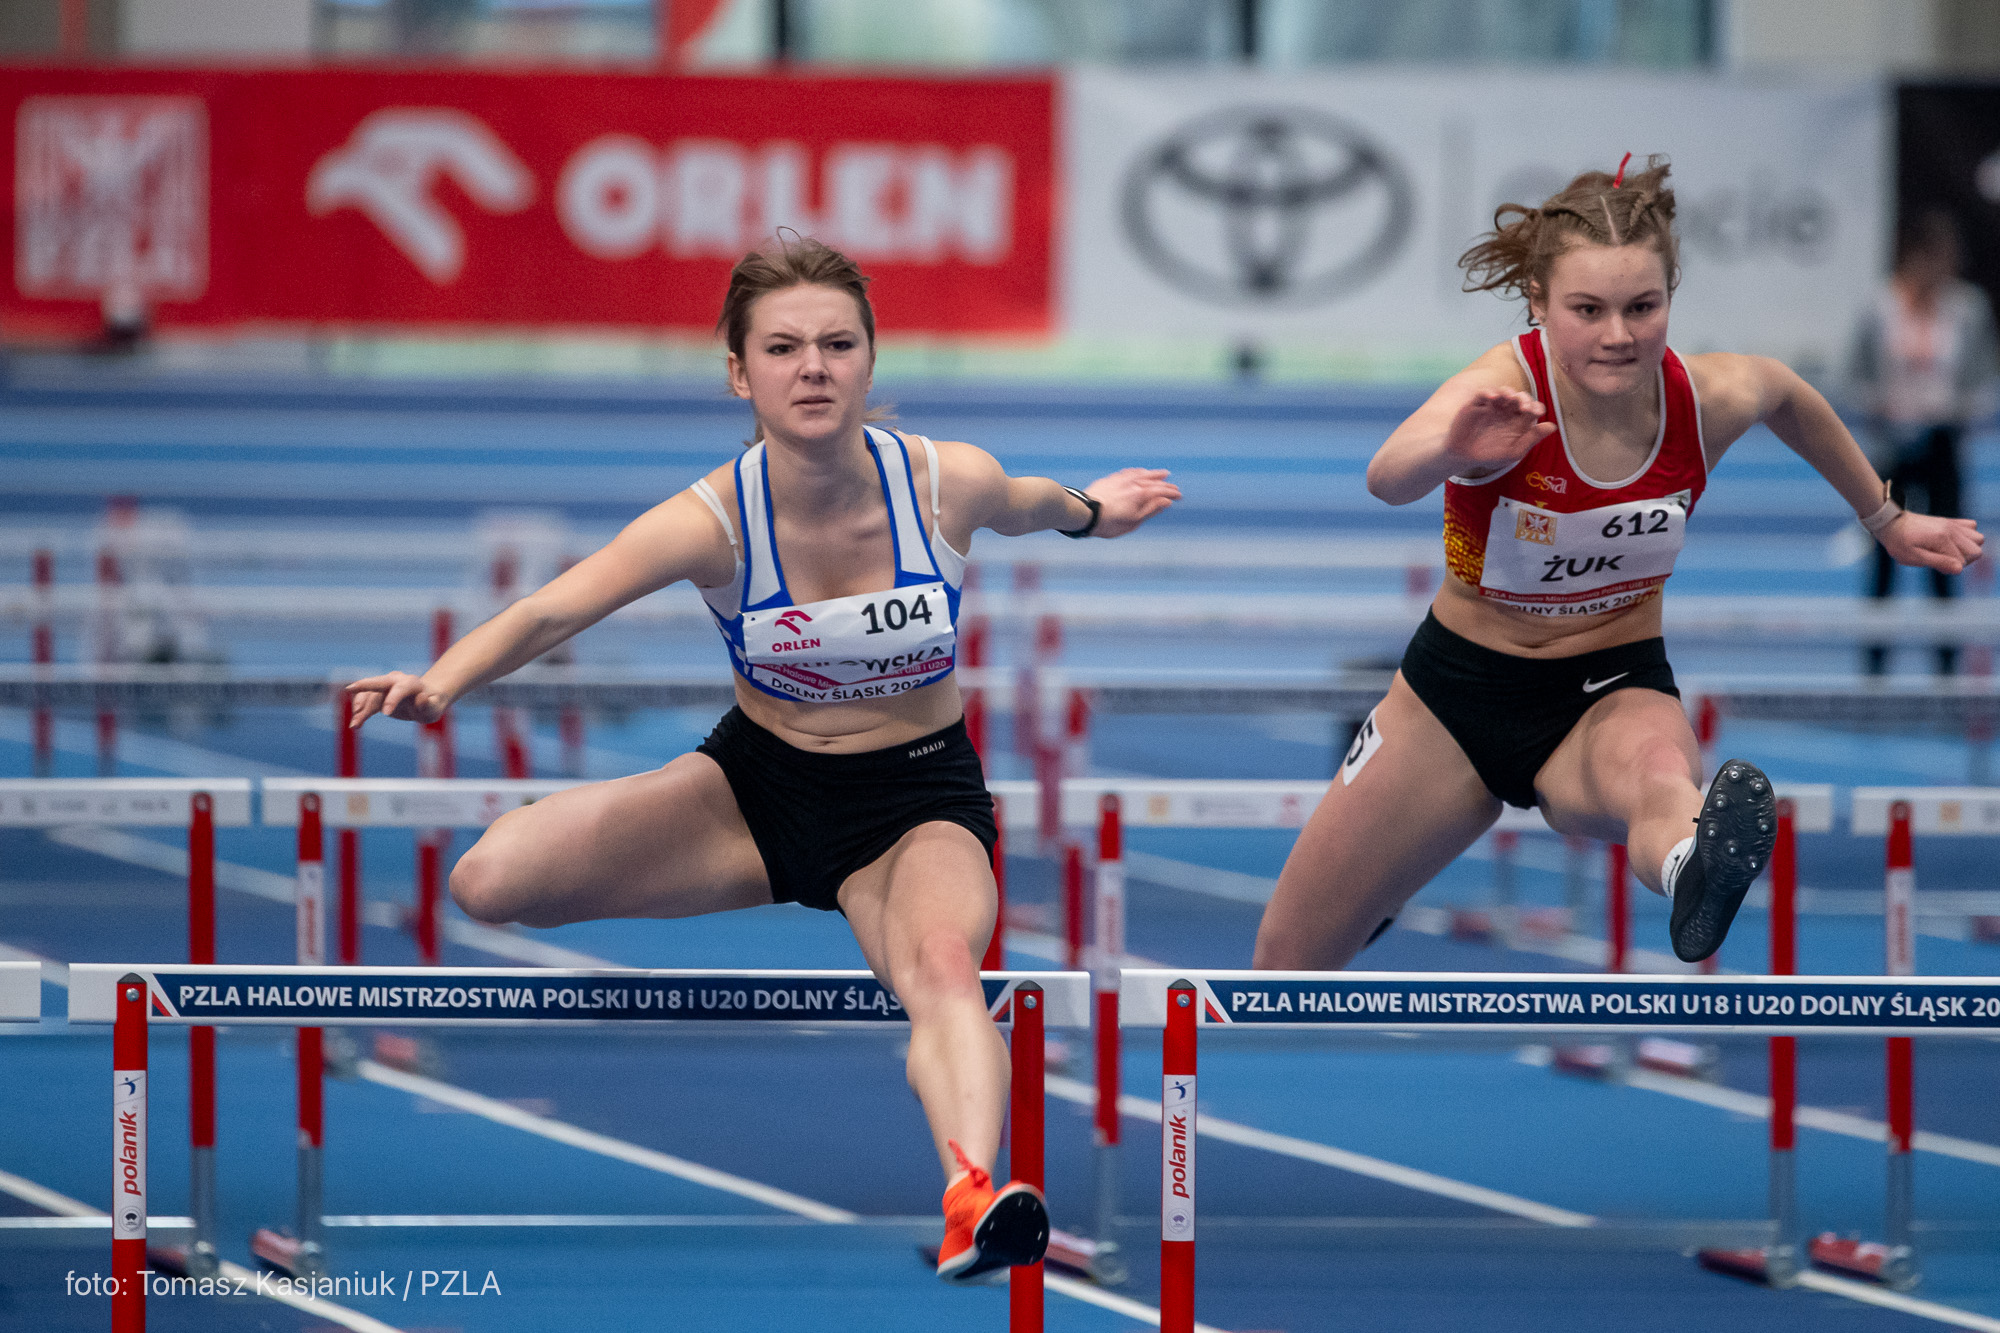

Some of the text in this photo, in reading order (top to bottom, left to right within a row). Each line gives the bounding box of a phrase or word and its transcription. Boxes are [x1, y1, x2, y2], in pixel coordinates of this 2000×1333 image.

[557, 135, 1014, 264] ORLEN
[1601, 508, 1669, 539] 612
[1540, 555, 1625, 582] ŻUK
[862, 594, 933, 635] 104
[771, 637, 822, 653] ORLEN
[782, 667, 817, 684] Halowe
[928, 660, 947, 670] U20
[771, 677, 827, 700] DOLNY
[832, 684, 886, 701] ŚLĄSK
[891, 677, 929, 694] 202
[908, 740, 946, 759] NABAIJI
[181, 985, 903, 1016] PZLA HALOWE MISTRZOSTWA POLSKI U18 i U20 DOLNY ŚLĄS
[1232, 991, 1293, 1012] PZLA
[1299, 992, 1403, 1013] HALOWE
[1408, 993, 1585, 1014] MISTRZOSTWA
[1590, 994, 1676, 1015] POLSKI
[1682, 994, 1730, 1015] U18
[1735, 994, 1742, 1015] i
[1748, 995, 1795, 1015] U20
[1801, 996, 1886, 1017] DOLNY
[1890, 992, 1968, 1022] ŚLĄSK
[119, 1110, 141, 1196] polanik
[1169, 1114, 1190, 1199] polanik
